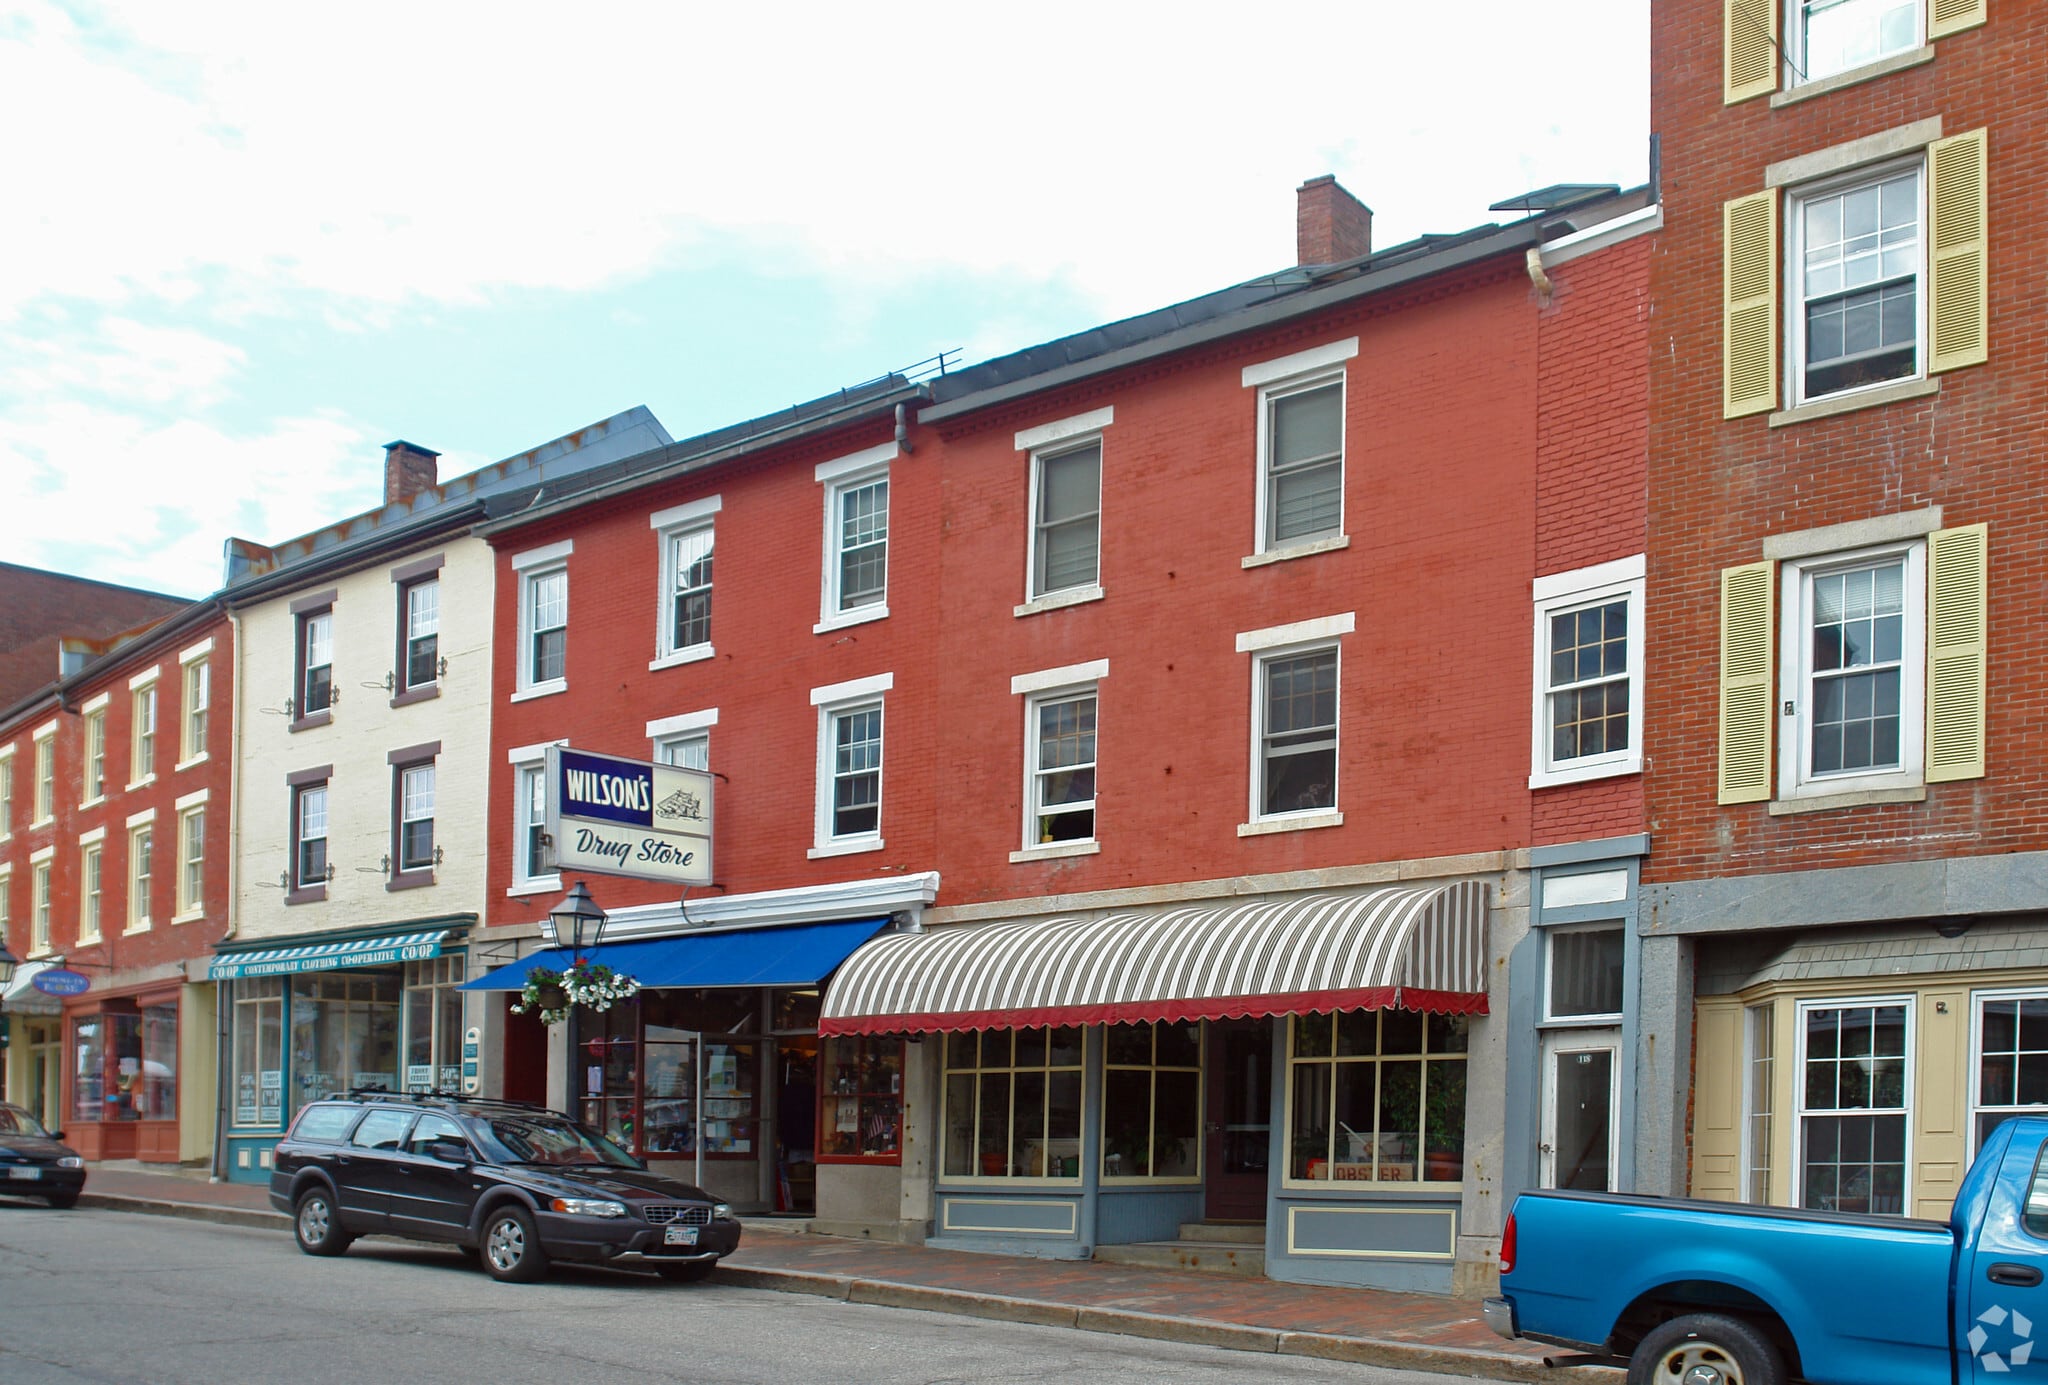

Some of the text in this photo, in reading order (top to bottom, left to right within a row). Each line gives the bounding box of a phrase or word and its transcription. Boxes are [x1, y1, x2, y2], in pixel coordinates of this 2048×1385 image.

[567, 769, 650, 812] WILSON'S
[576, 828, 694, 868] Drug Store
[244, 960, 298, 975] CONTEMPORARY
[301, 956, 338, 970] CLOTHING
[341, 949, 396, 966] CO-OPERATIVE
